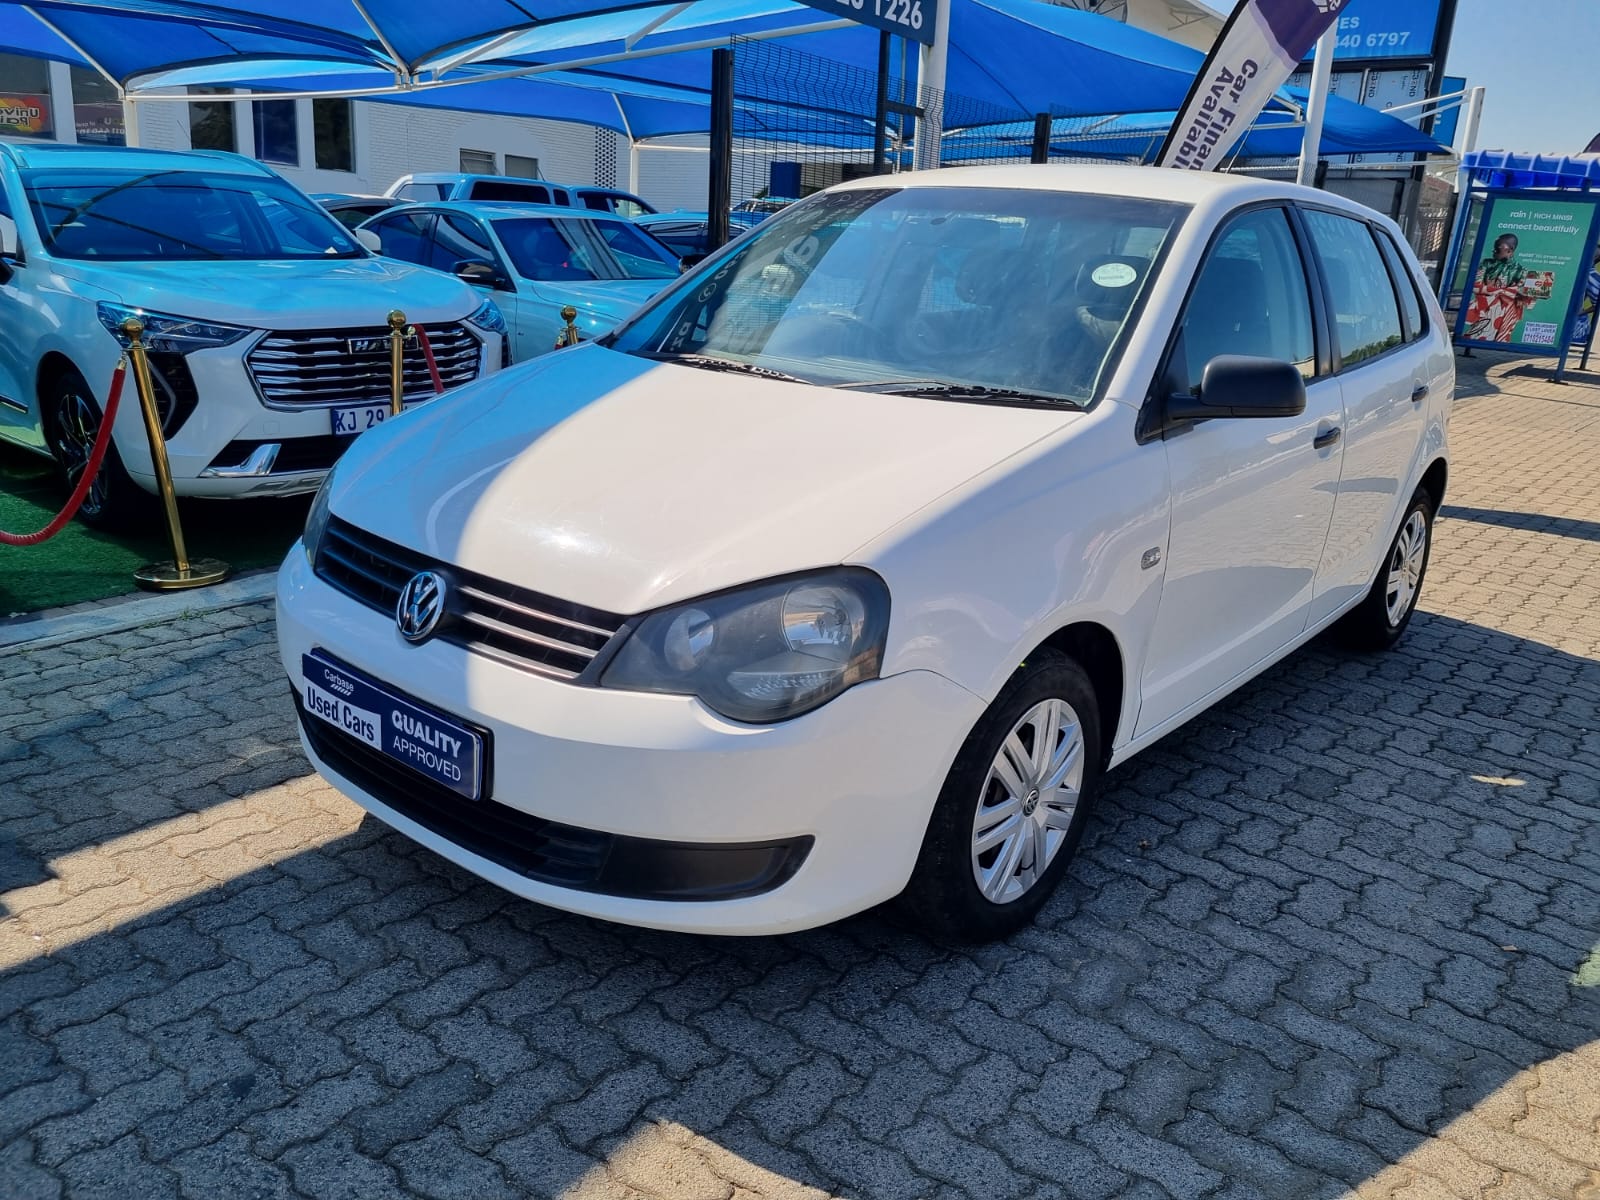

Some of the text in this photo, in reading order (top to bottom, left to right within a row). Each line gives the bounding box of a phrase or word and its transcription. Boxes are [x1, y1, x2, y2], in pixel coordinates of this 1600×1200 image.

[1338, 16, 1360, 30] ES
[1366, 32, 1411, 47] 6797
[1229, 58, 1259, 104] Car
[1510, 210, 1527, 218] rain
[1498, 221, 1579, 235] connect beautifully
[335, 411, 357, 432] KJ
[324, 668, 355, 692] Carbase
[307, 686, 375, 742] Used Cars
[391, 709, 462, 759] QUALITY
[392, 735, 462, 782] APPROVED
